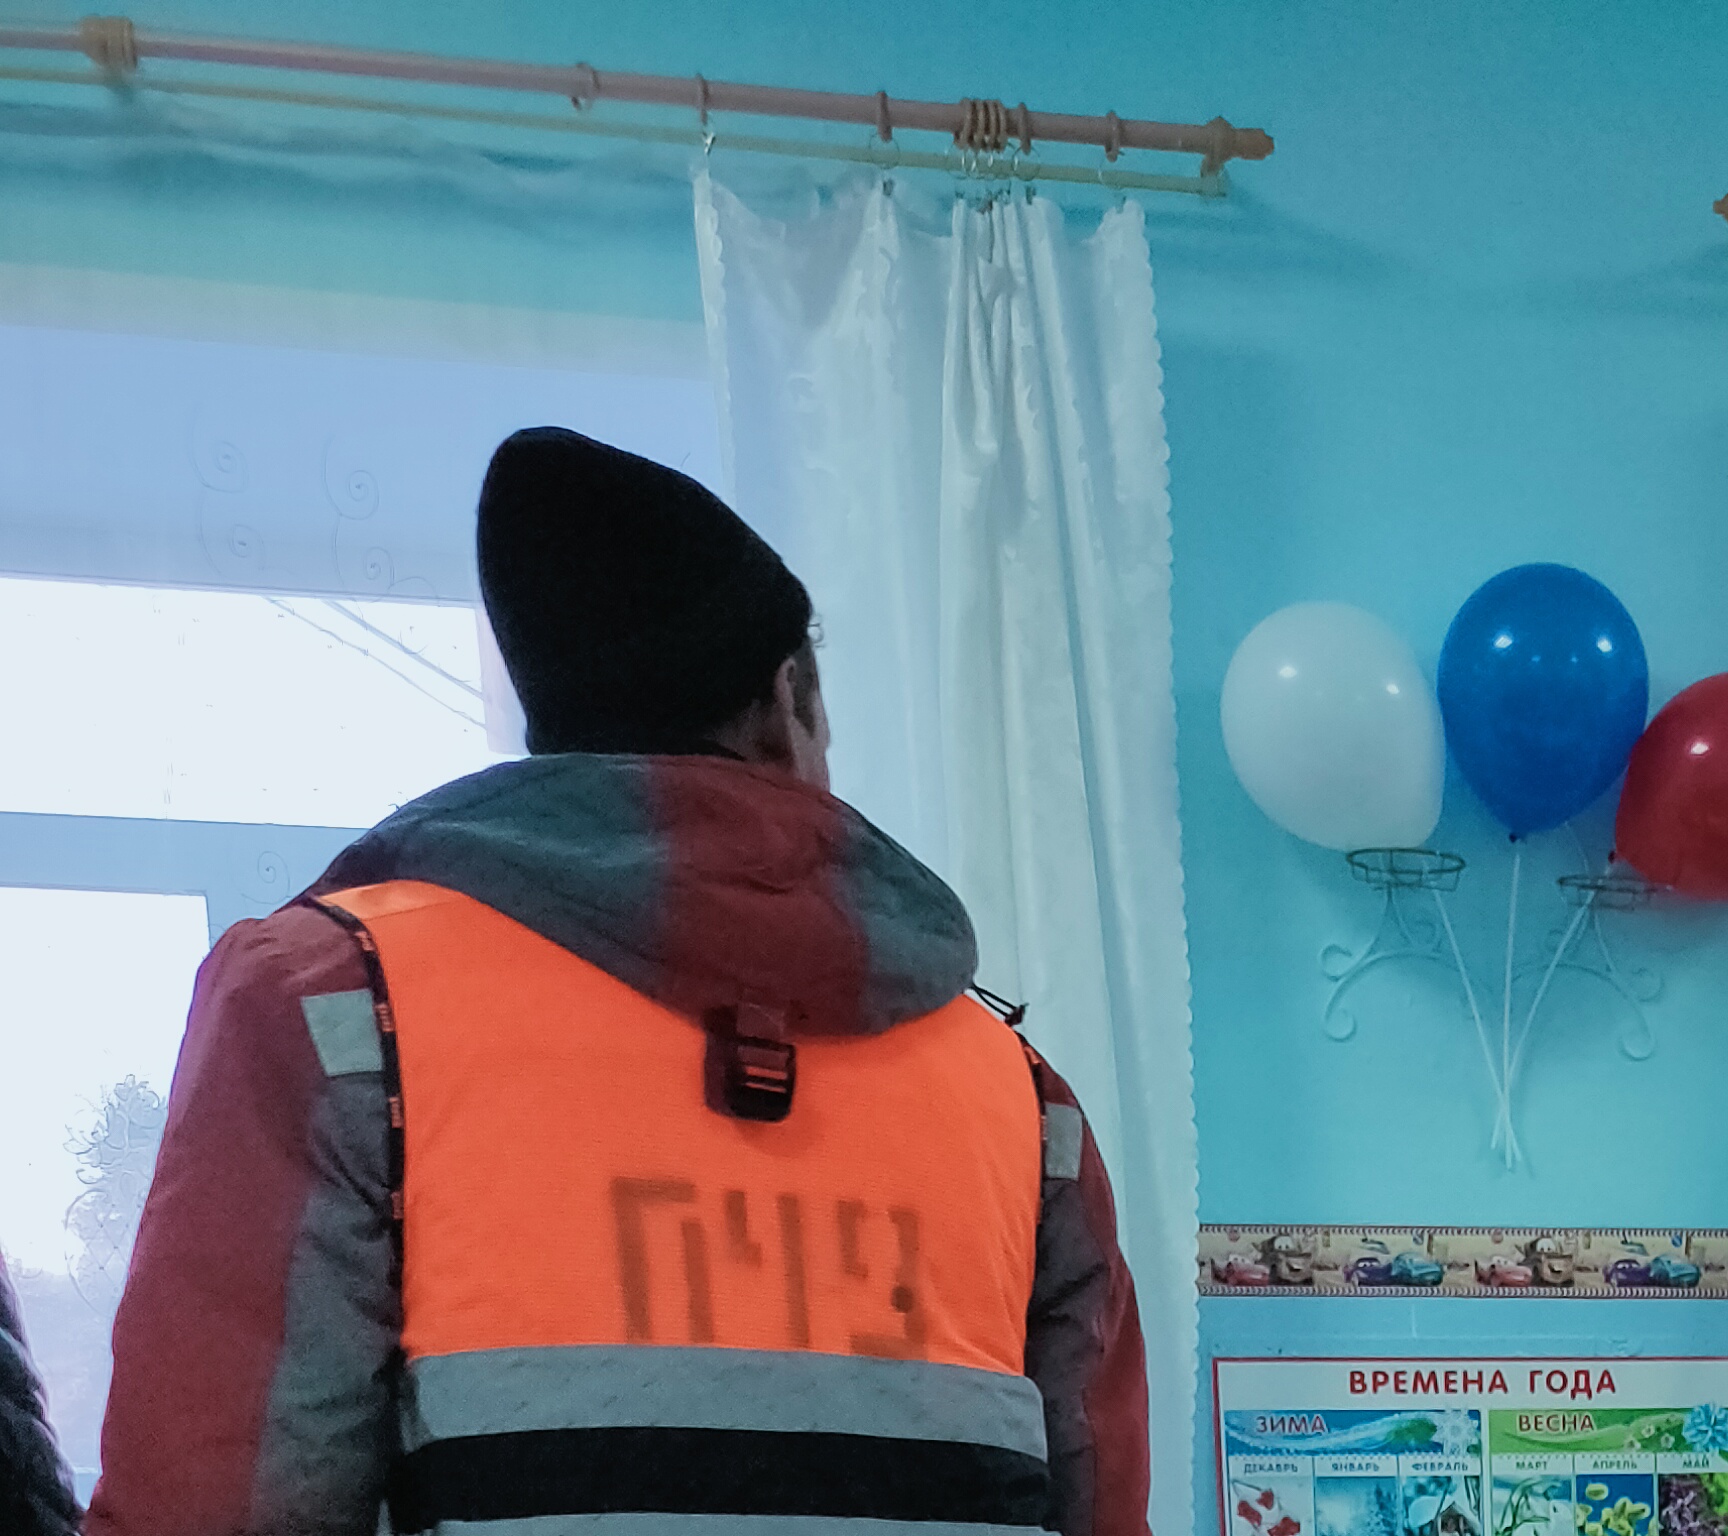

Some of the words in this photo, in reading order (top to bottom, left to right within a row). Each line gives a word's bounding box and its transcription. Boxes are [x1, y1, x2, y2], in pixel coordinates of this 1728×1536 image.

[1349, 1369, 1509, 1394] ВРЕМЕНА
[1529, 1369, 1616, 1400] ГОДА
[1256, 1415, 1328, 1434] ЗИМА
[1518, 1413, 1595, 1433] ВЕСНА
[1243, 1463, 1299, 1474] ДЕКАБРЬ
[1331, 1462, 1380, 1473] ЯНВАРЬ
[1411, 1462, 1469, 1472] ФЕВРАЛЬ
[1515, 1460, 1548, 1471] МАРТ
[1592, 1459, 1638, 1470] АПРЕЛЬ
[1682, 1457, 1710, 1469] МАЙ
